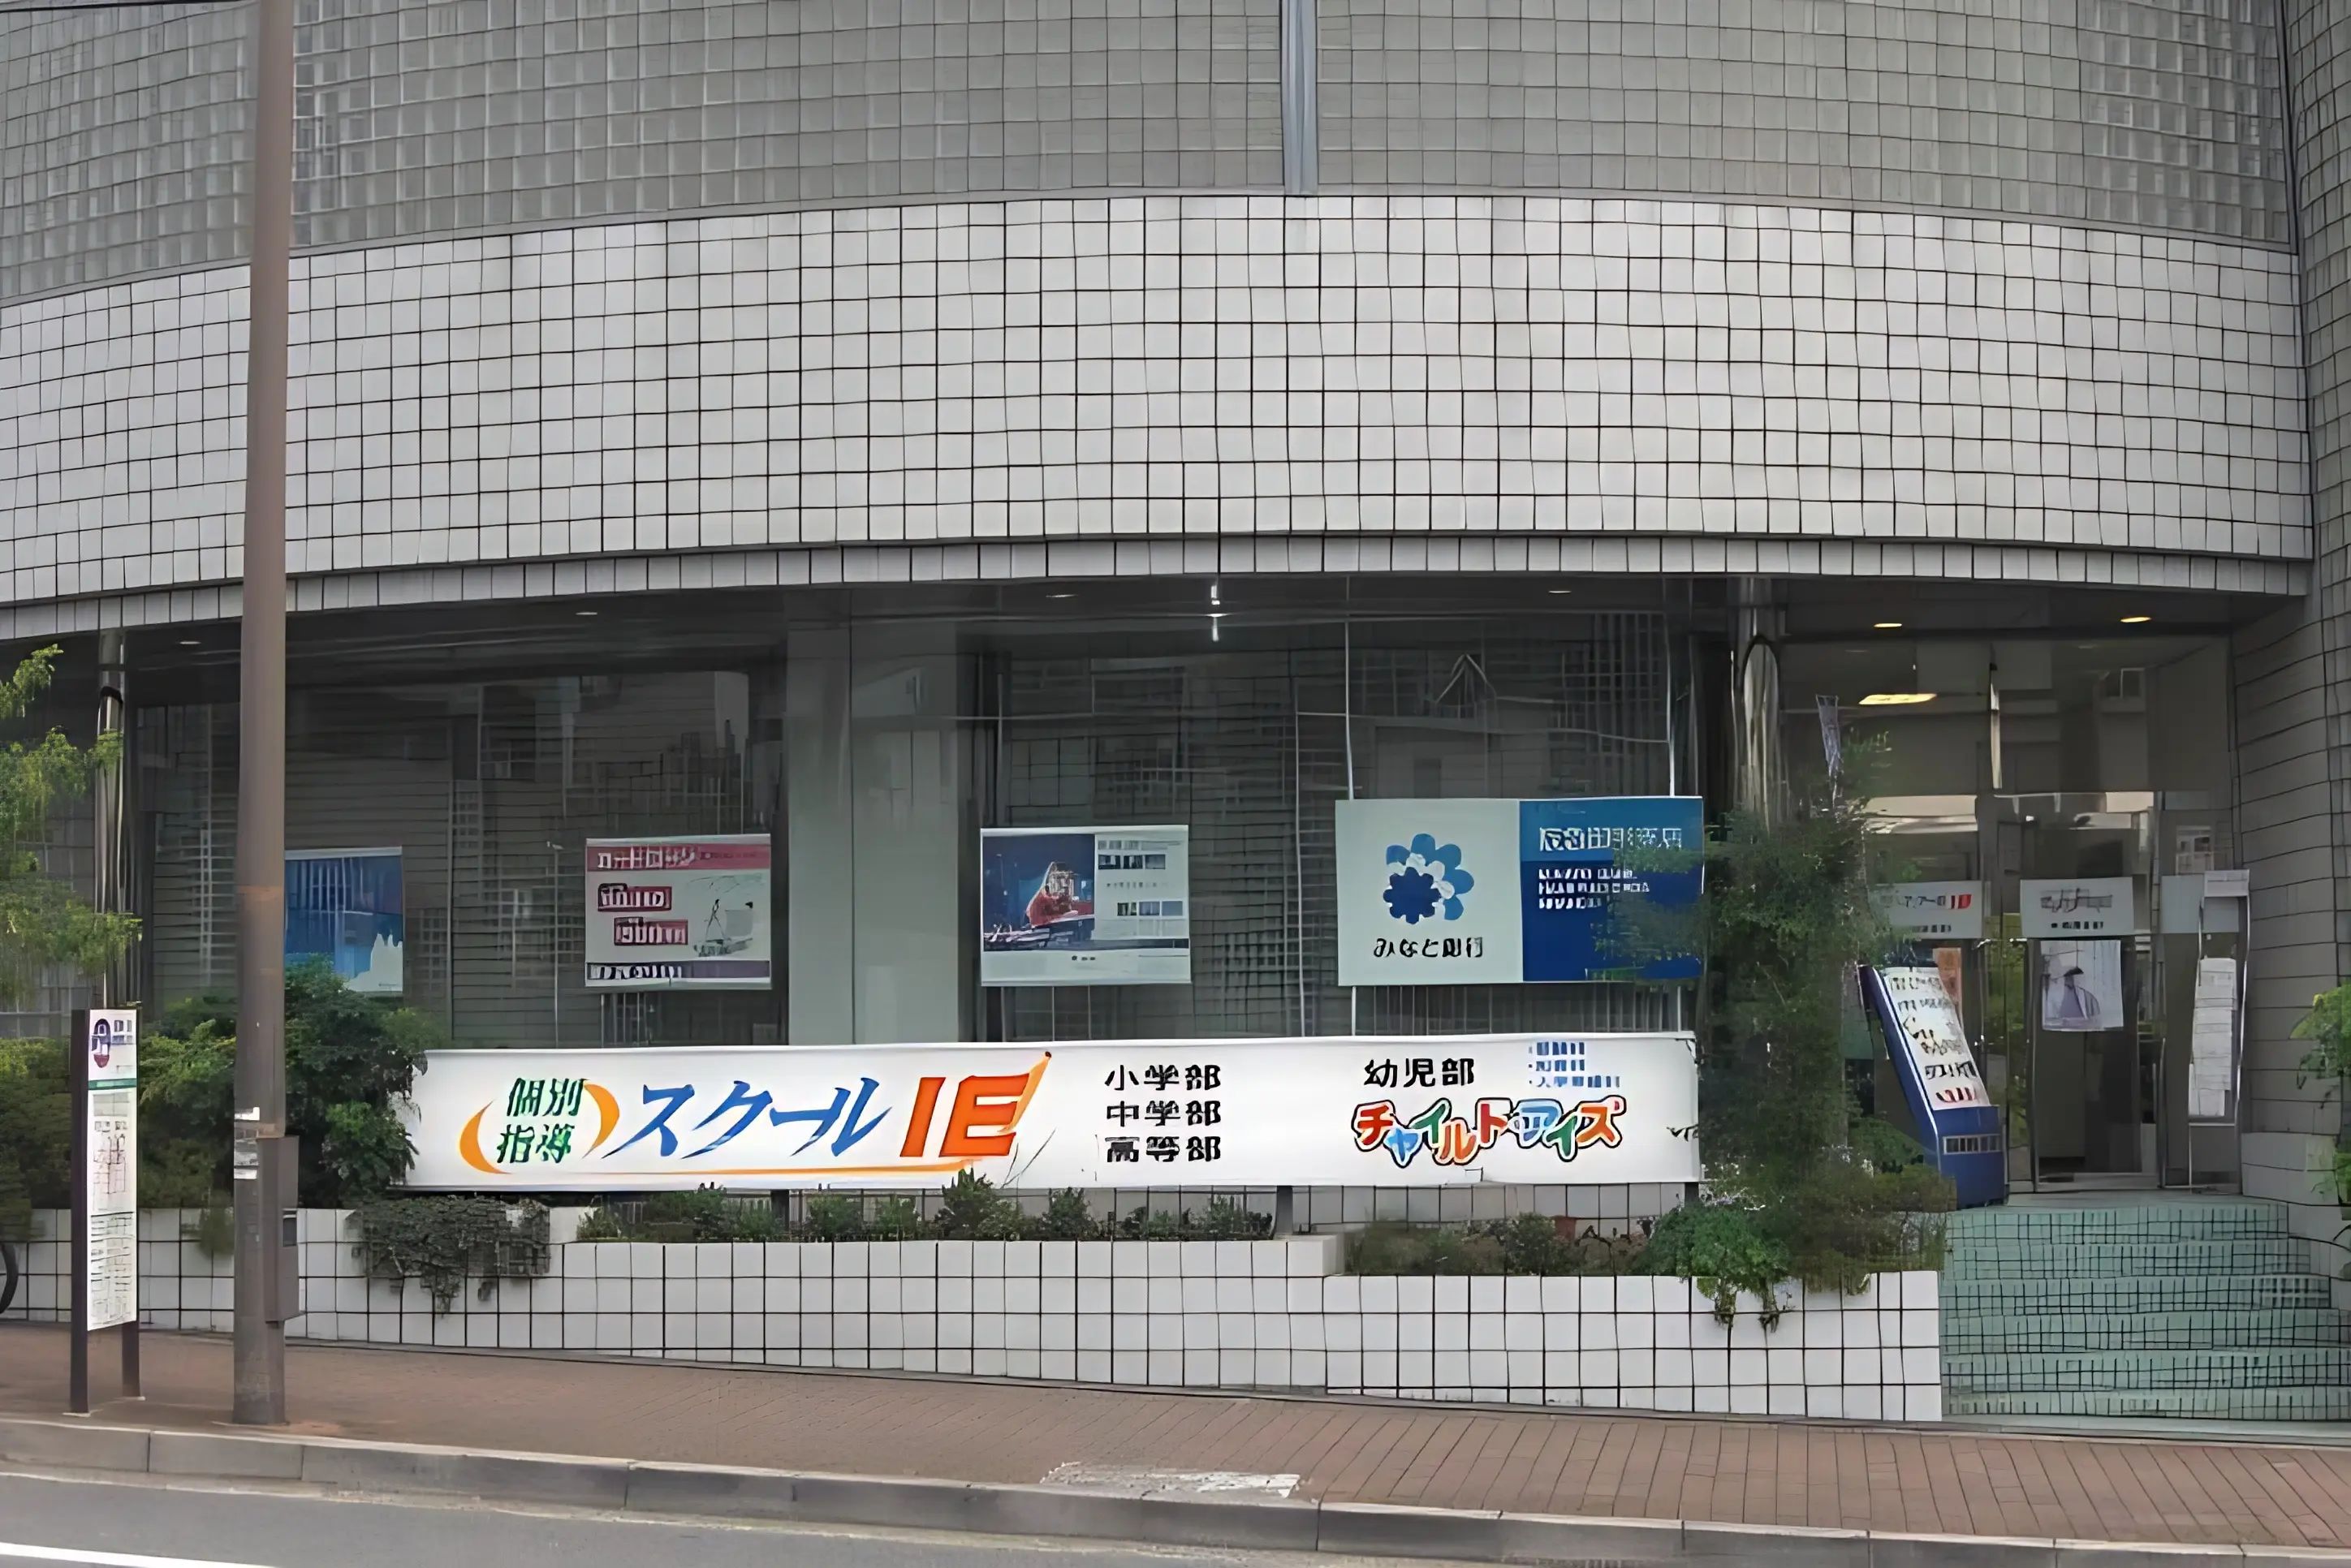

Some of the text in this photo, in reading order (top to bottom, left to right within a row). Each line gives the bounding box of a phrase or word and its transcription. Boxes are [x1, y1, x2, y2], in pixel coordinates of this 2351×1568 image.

[1104, 1064, 1221, 1091] 小学部
[1364, 1058, 1474, 1088] 幼児部
[506, 1077, 588, 1117] 個別
[1106, 1101, 1221, 1127] 中学部
